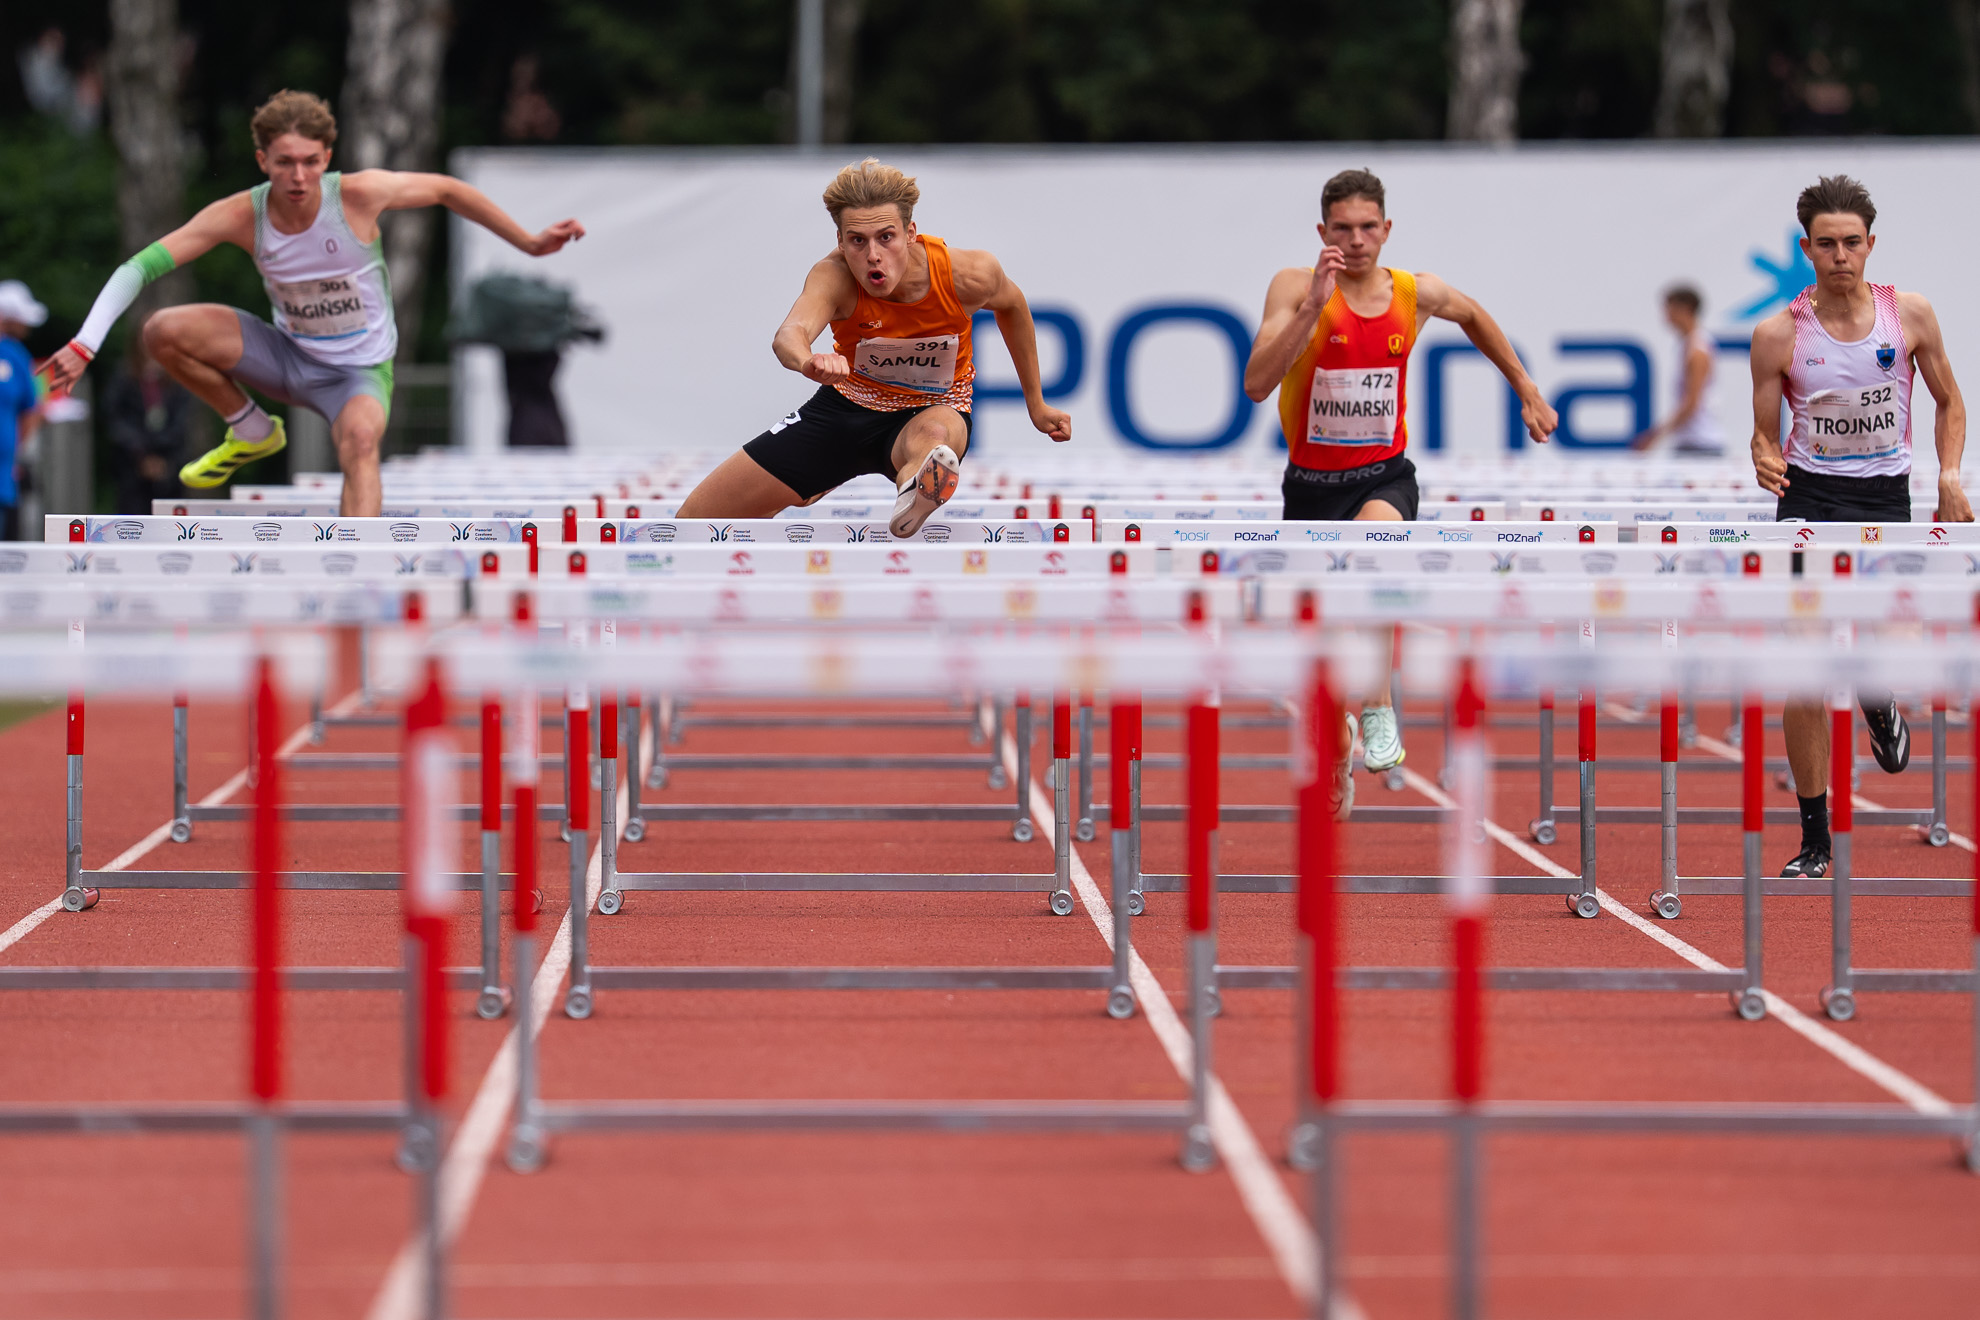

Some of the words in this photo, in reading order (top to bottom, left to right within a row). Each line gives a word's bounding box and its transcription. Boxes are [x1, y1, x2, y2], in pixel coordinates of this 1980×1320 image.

[320, 280, 351, 293] 301
[915, 341, 949, 352] 391
[869, 354, 940, 367] SAMUL
[1361, 373, 1393, 388] 472
[1860, 387, 1892, 407] 532
[1313, 398, 1394, 417] WINIARSKI
[1812, 411, 1896, 435] TROJNAR
[1294, 469, 1342, 483] NIKE
[1342, 463, 1386, 482] PRO
[1180, 530, 1210, 542] posir
[1311, 530, 1342, 542] posir
[1443, 531, 1473, 542] posir
